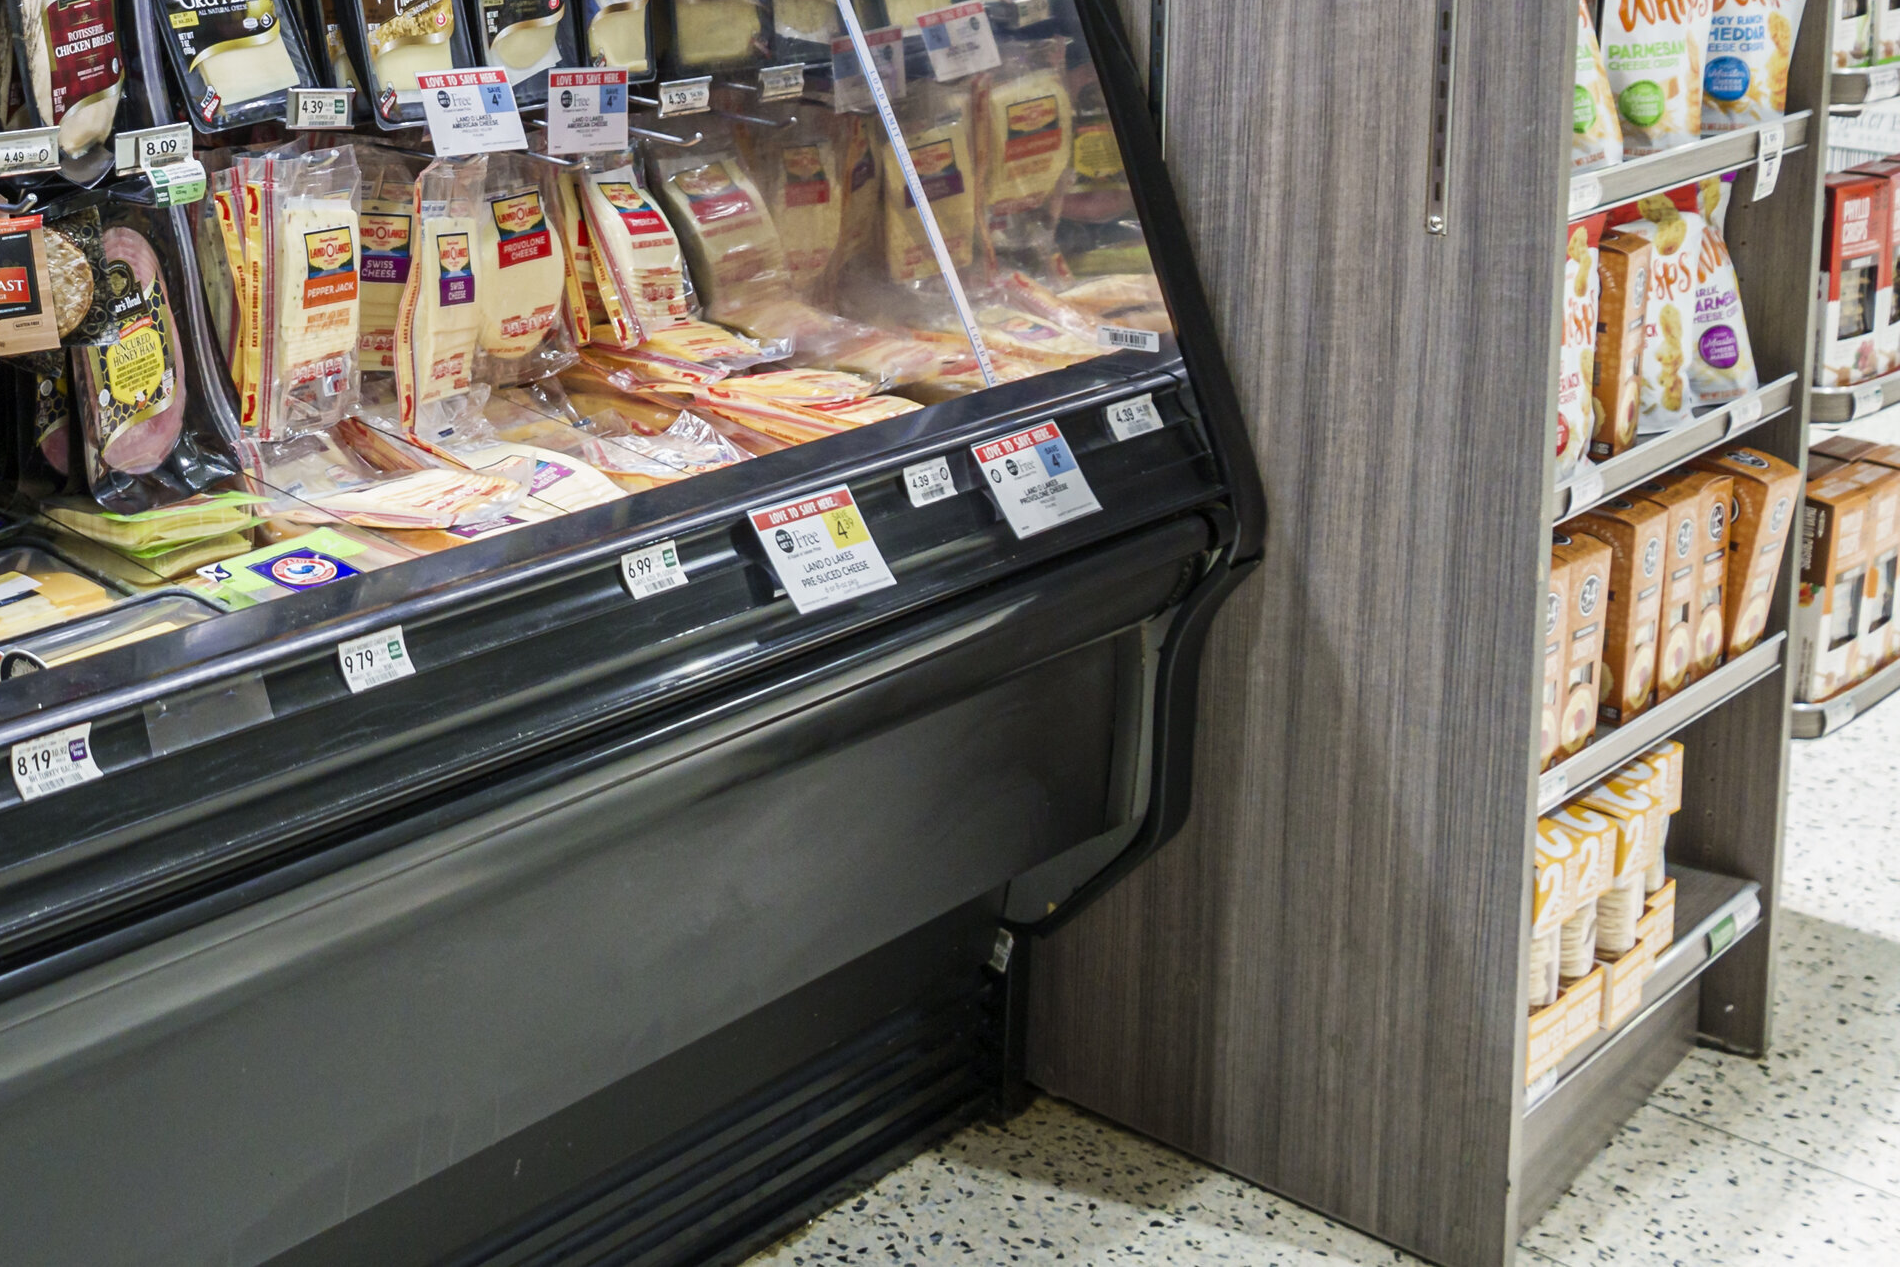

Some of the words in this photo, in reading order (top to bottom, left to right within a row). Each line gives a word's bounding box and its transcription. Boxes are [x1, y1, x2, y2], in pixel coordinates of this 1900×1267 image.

[67, 26, 104, 42] ROTISSERIE
[55, 39, 90, 58] CHICKEN
[92, 32, 115, 49] BREAST
[1608, 39, 1685, 59] PARMESAN
[1608, 60, 1646, 71] CHEESE
[503, 236, 546, 253] PROVOLONE
[511, 246, 538, 259] CHEESE
[361, 268, 397, 279] CHEESE
[366, 260, 394, 270] SWISS
[308, 285, 334, 299] PEPPER
[335, 281, 355, 293] JACK
[116, 333, 151, 354] UNCURED
[113, 345, 139, 366] HONEY
[139, 342, 157, 359] HAM
[803, 559, 825, 573] LAND
[832, 550, 855, 565] LAKES
[801, 567, 842, 588] PRE-SLICED
[842, 561, 870, 576] CHEESE
[343, 648, 375, 674] 9.79
[16, 750, 51, 777] 8.19
